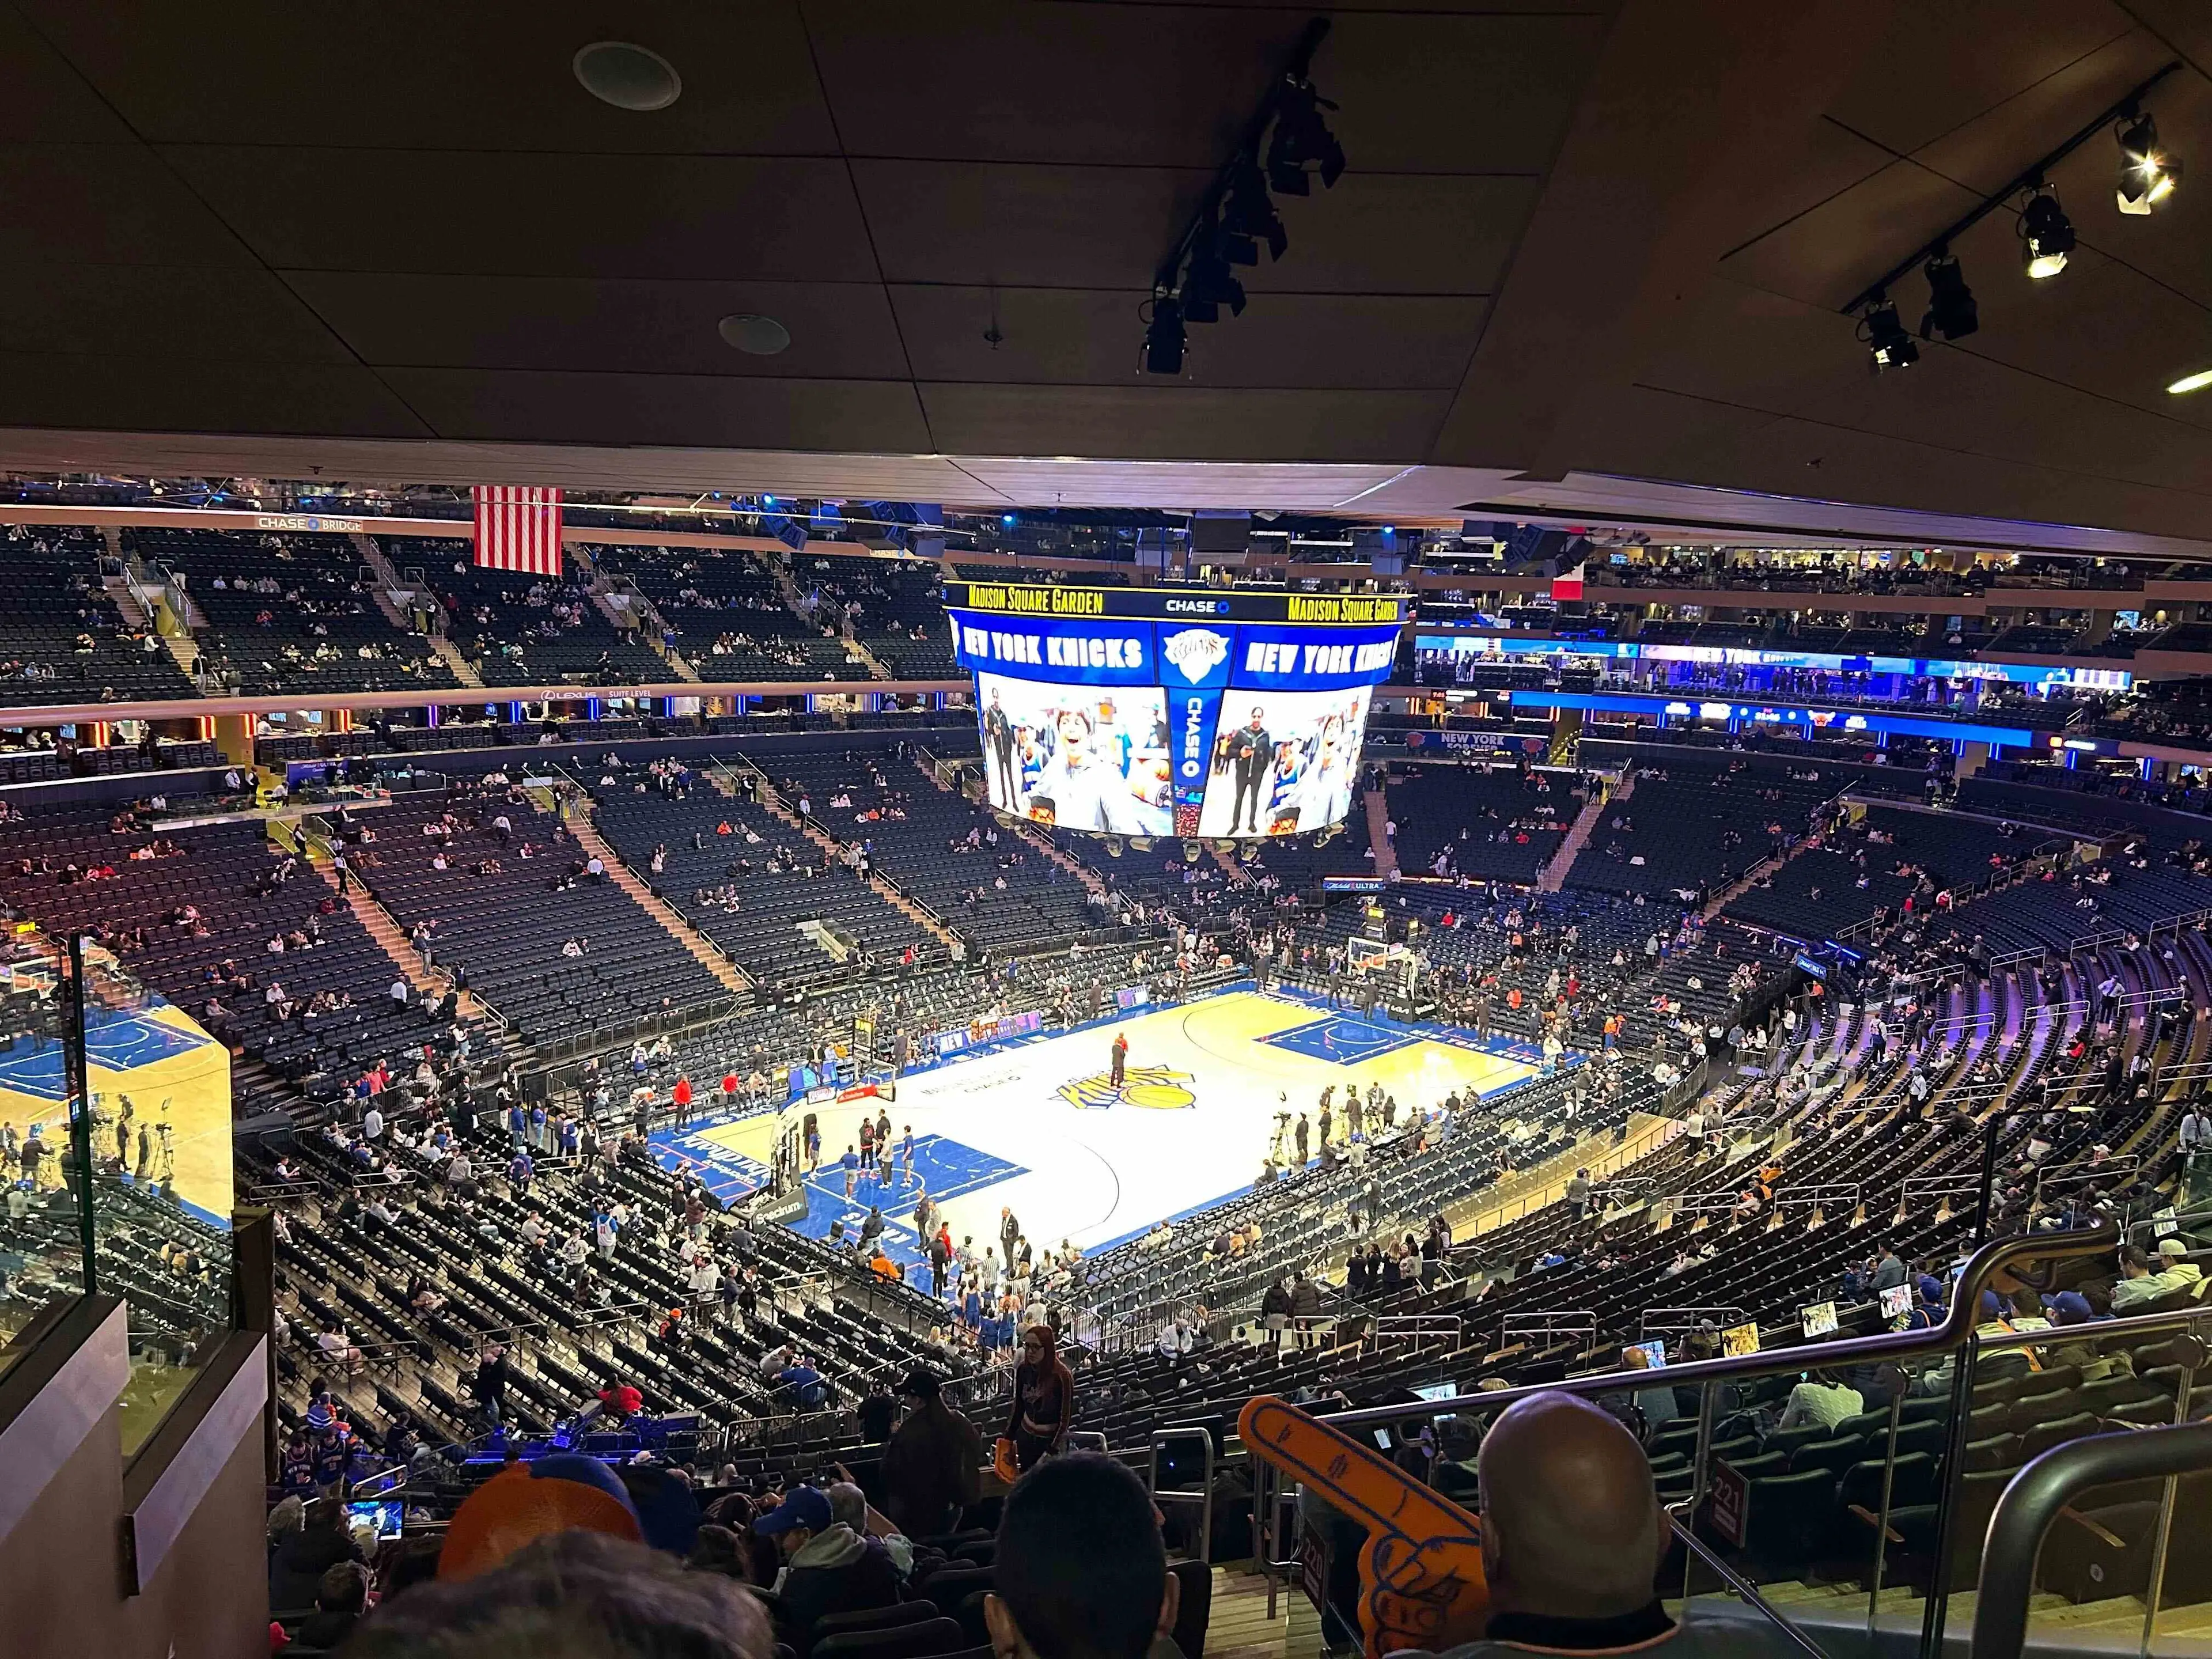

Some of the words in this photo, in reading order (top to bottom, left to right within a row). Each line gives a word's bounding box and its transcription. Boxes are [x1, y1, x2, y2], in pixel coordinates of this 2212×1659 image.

[259, 517, 306, 529] CHASE
[323, 520, 362, 531] BRIDGE
[968, 584, 1006, 609] MADISON
[1007, 586, 1049, 612] SQUARE
[1052, 588, 1104, 614] GARDEN
[1166, 600, 1216, 613] CHASE
[1287, 597, 1339, 621] MADISON
[1340, 597, 1374, 623] SQUARE
[1374, 598, 1398, 620] GARDEN
[963, 626, 988, 658] NEW
[991, 632, 1042, 665] YORK
[1046, 637, 1143, 668] KNICKS
[1245, 642, 1299, 673] NEW
[1304, 645, 1355, 673] YORK
[1184, 697, 1202, 759] CHASE
[1441, 733, 1469, 744] NEW
[1472, 734, 1505, 746] YORK
[756, 1202, 800, 1225] Spectrum
[1714, 1475, 1739, 1514] 221
[1304, 1537, 1323, 1580] 220
